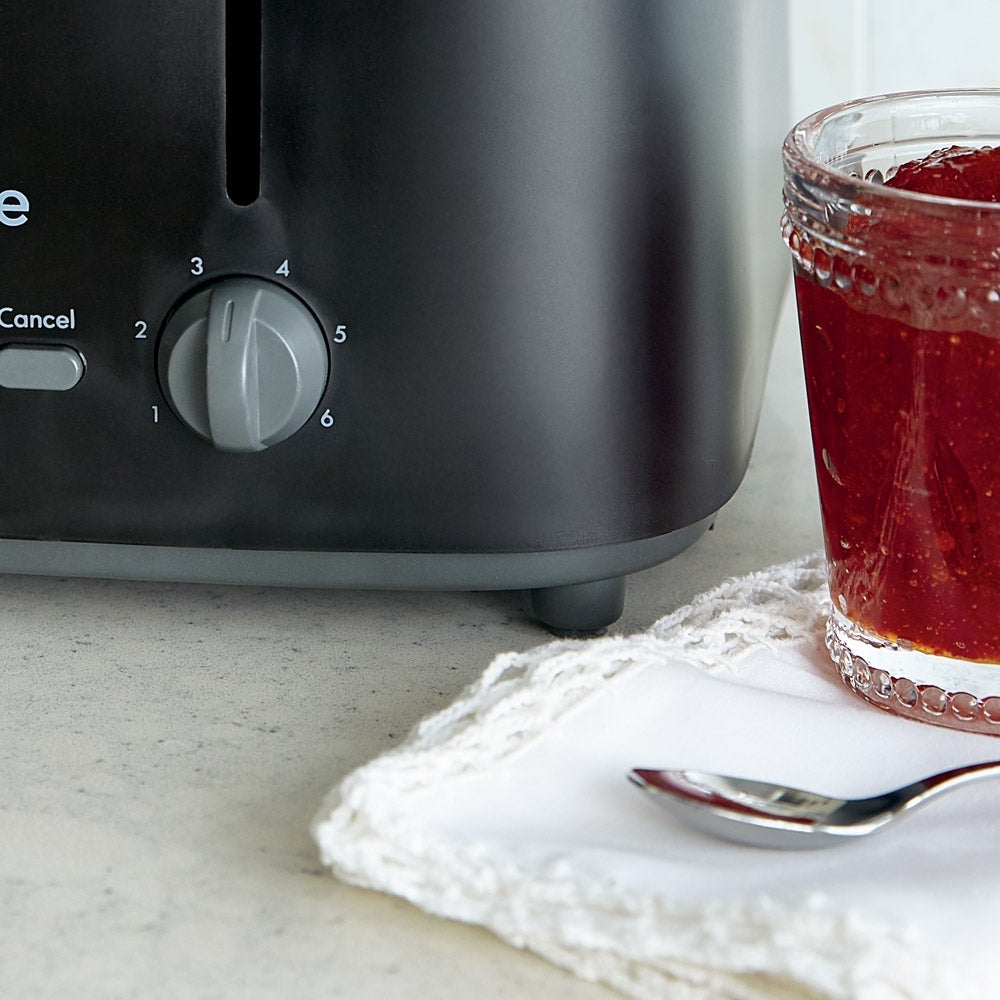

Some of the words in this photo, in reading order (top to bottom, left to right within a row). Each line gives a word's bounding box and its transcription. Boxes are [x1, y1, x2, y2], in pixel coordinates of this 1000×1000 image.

[190, 256, 204, 276] 3
[275, 259, 290, 278] 4
[134, 320, 147, 339] 2
[333, 324, 347, 344] 5
[151, 405, 159, 424] 1
[319, 408, 335, 428] 6
